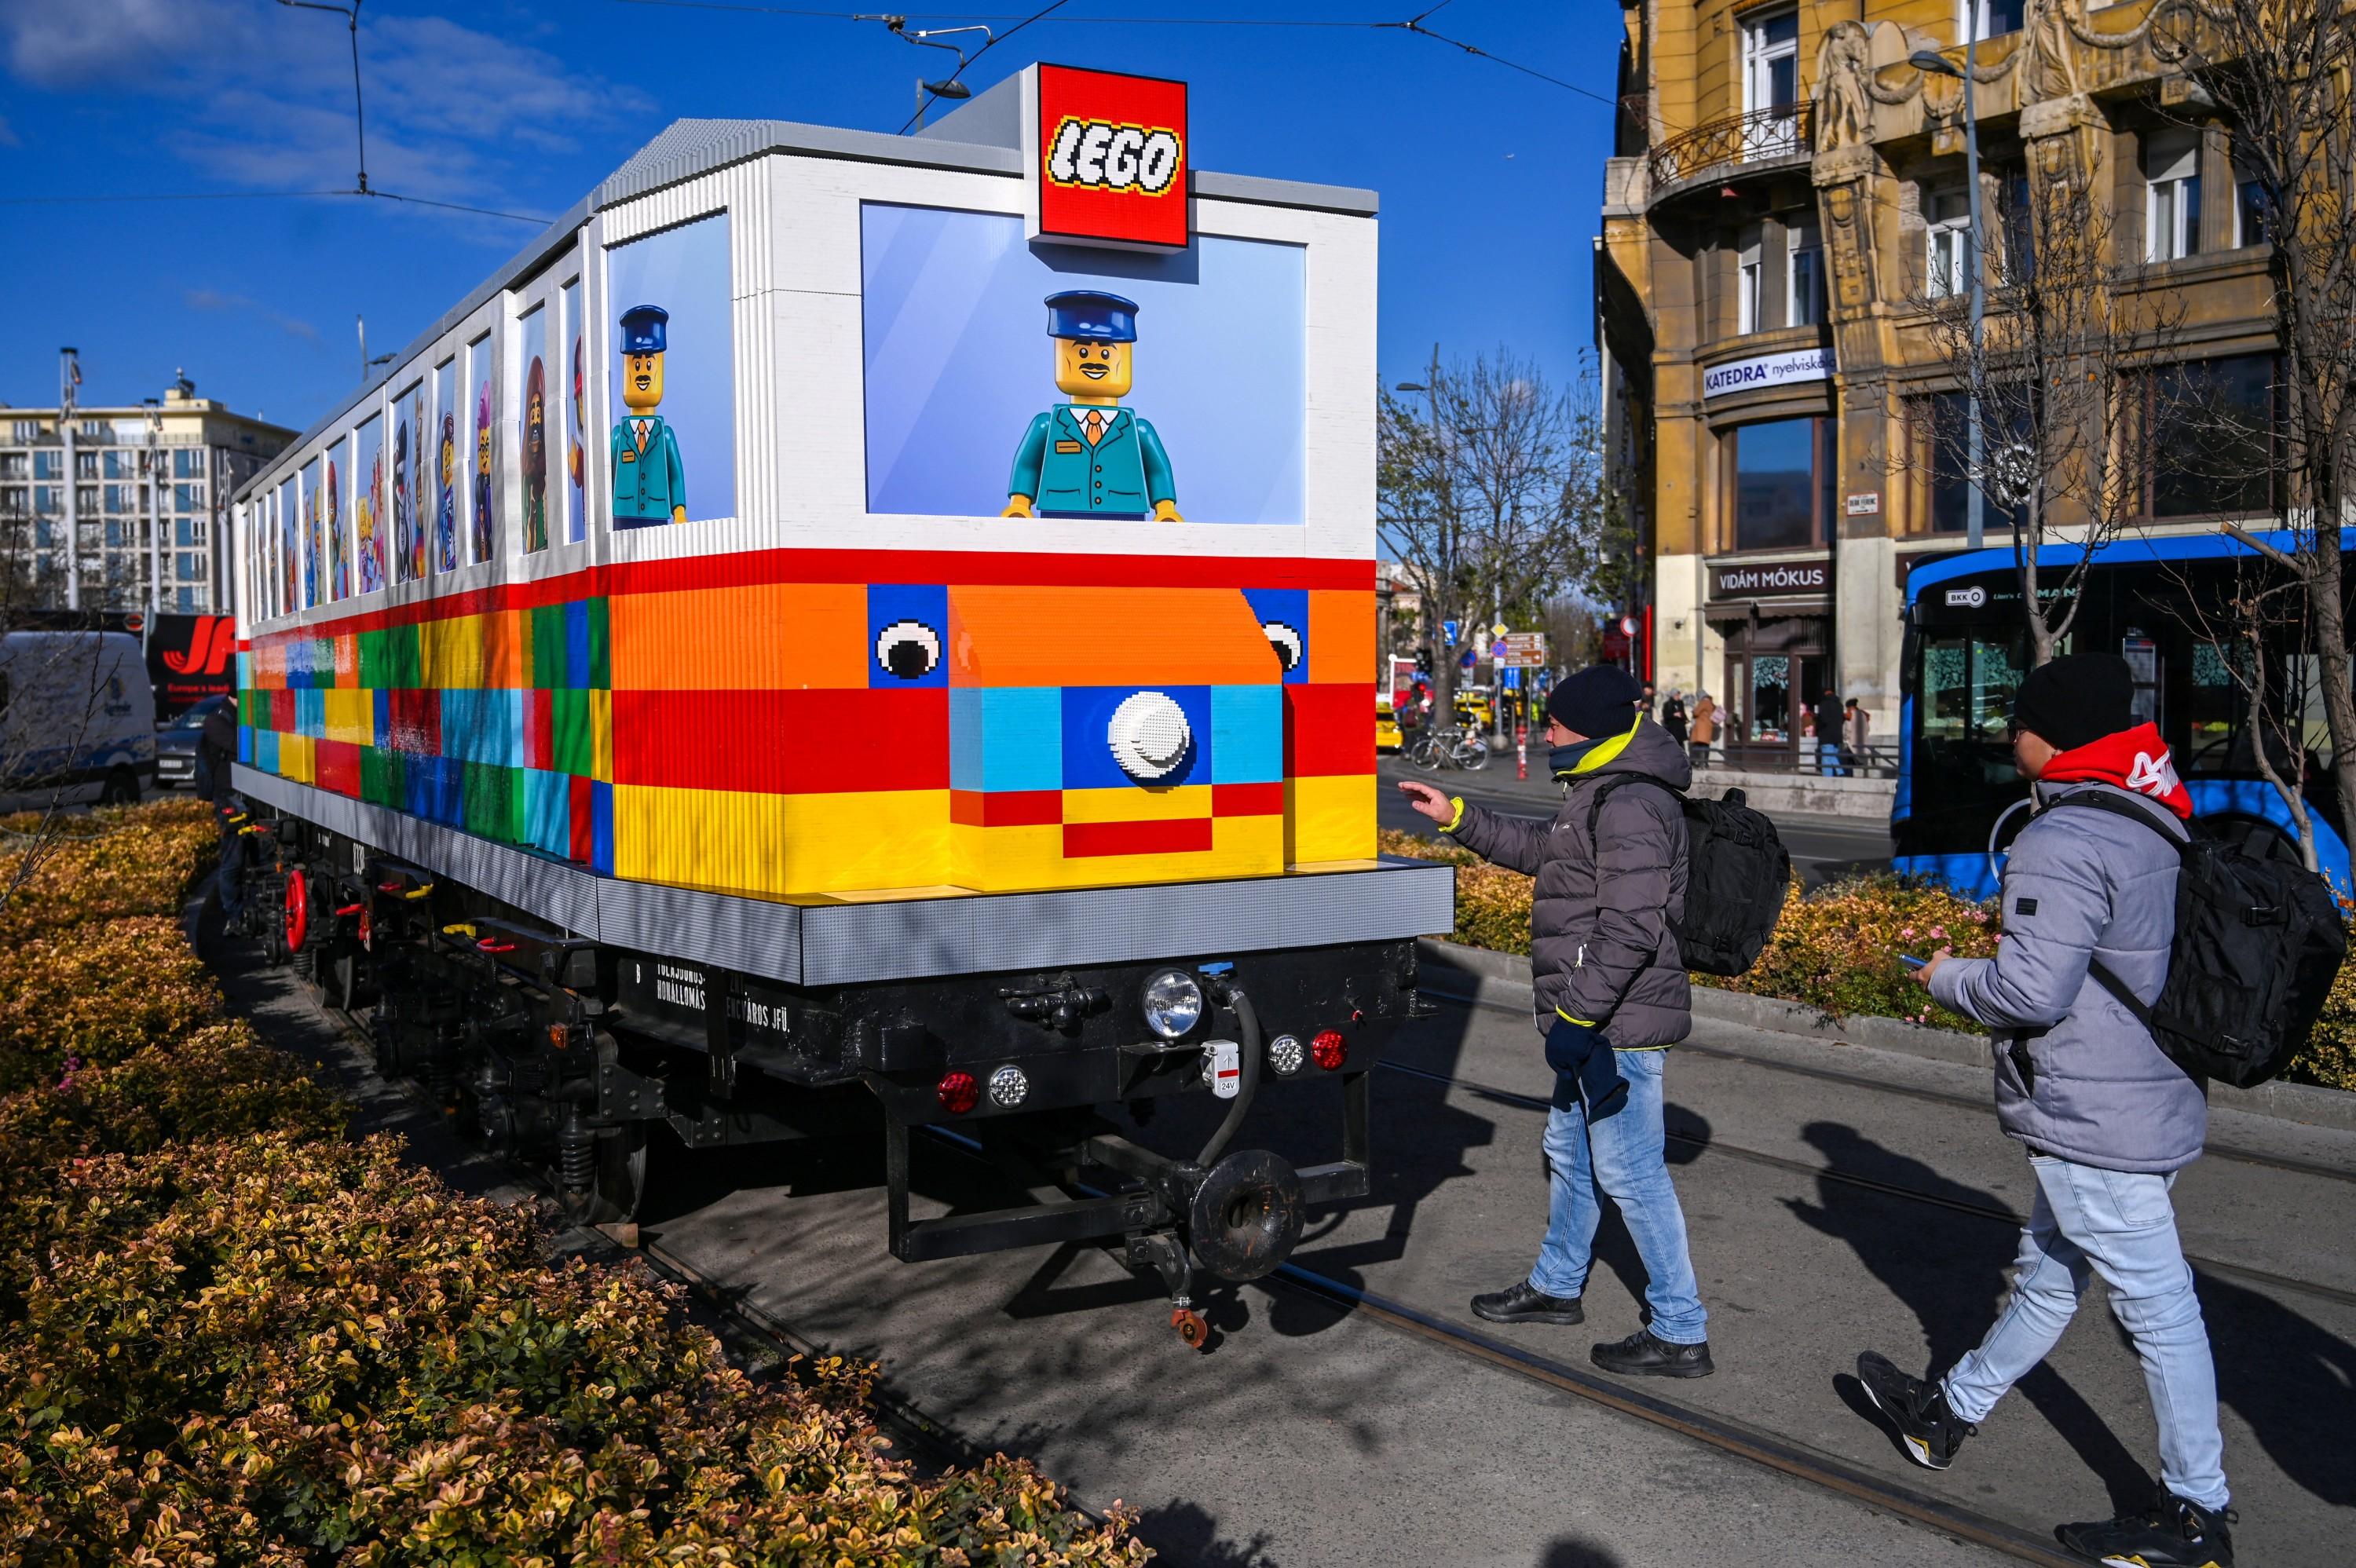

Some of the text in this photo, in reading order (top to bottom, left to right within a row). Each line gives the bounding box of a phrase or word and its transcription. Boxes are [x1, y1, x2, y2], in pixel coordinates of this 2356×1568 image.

[1048, 119, 1180, 193] LEGO
[1720, 567, 1824, 590] VIDÁM MÓKUS
[2037, 588, 2077, 598] MAN
[1221, 1081, 1235, 1091] 24V
